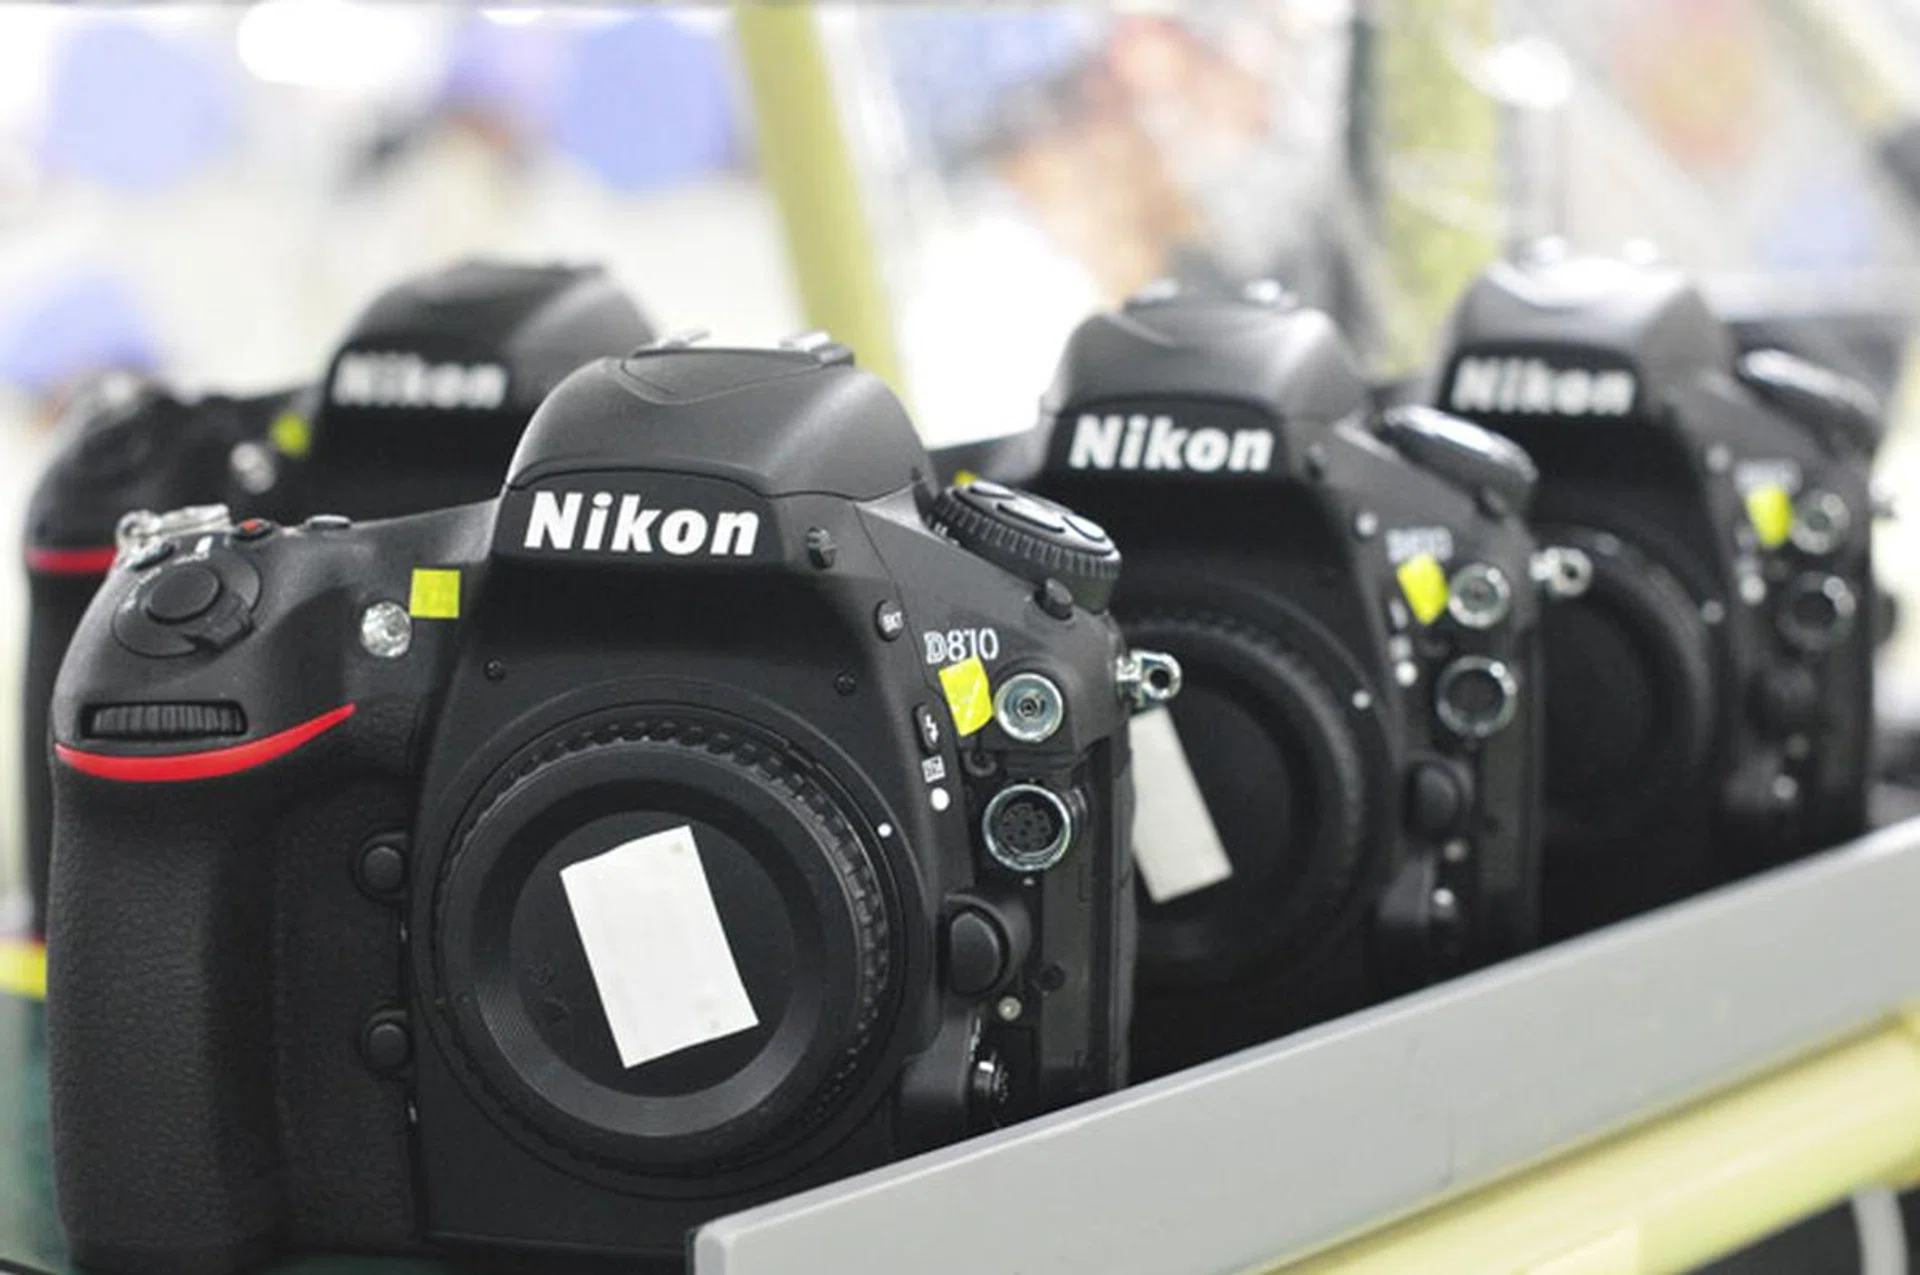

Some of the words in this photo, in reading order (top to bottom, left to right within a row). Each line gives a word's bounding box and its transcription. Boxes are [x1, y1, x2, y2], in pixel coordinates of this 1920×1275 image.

[1452, 356, 1634, 417] Nikon
[1068, 414, 1274, 472] Nikon
[523, 490, 760, 556] Nikon
[923, 627, 999, 665] D810
